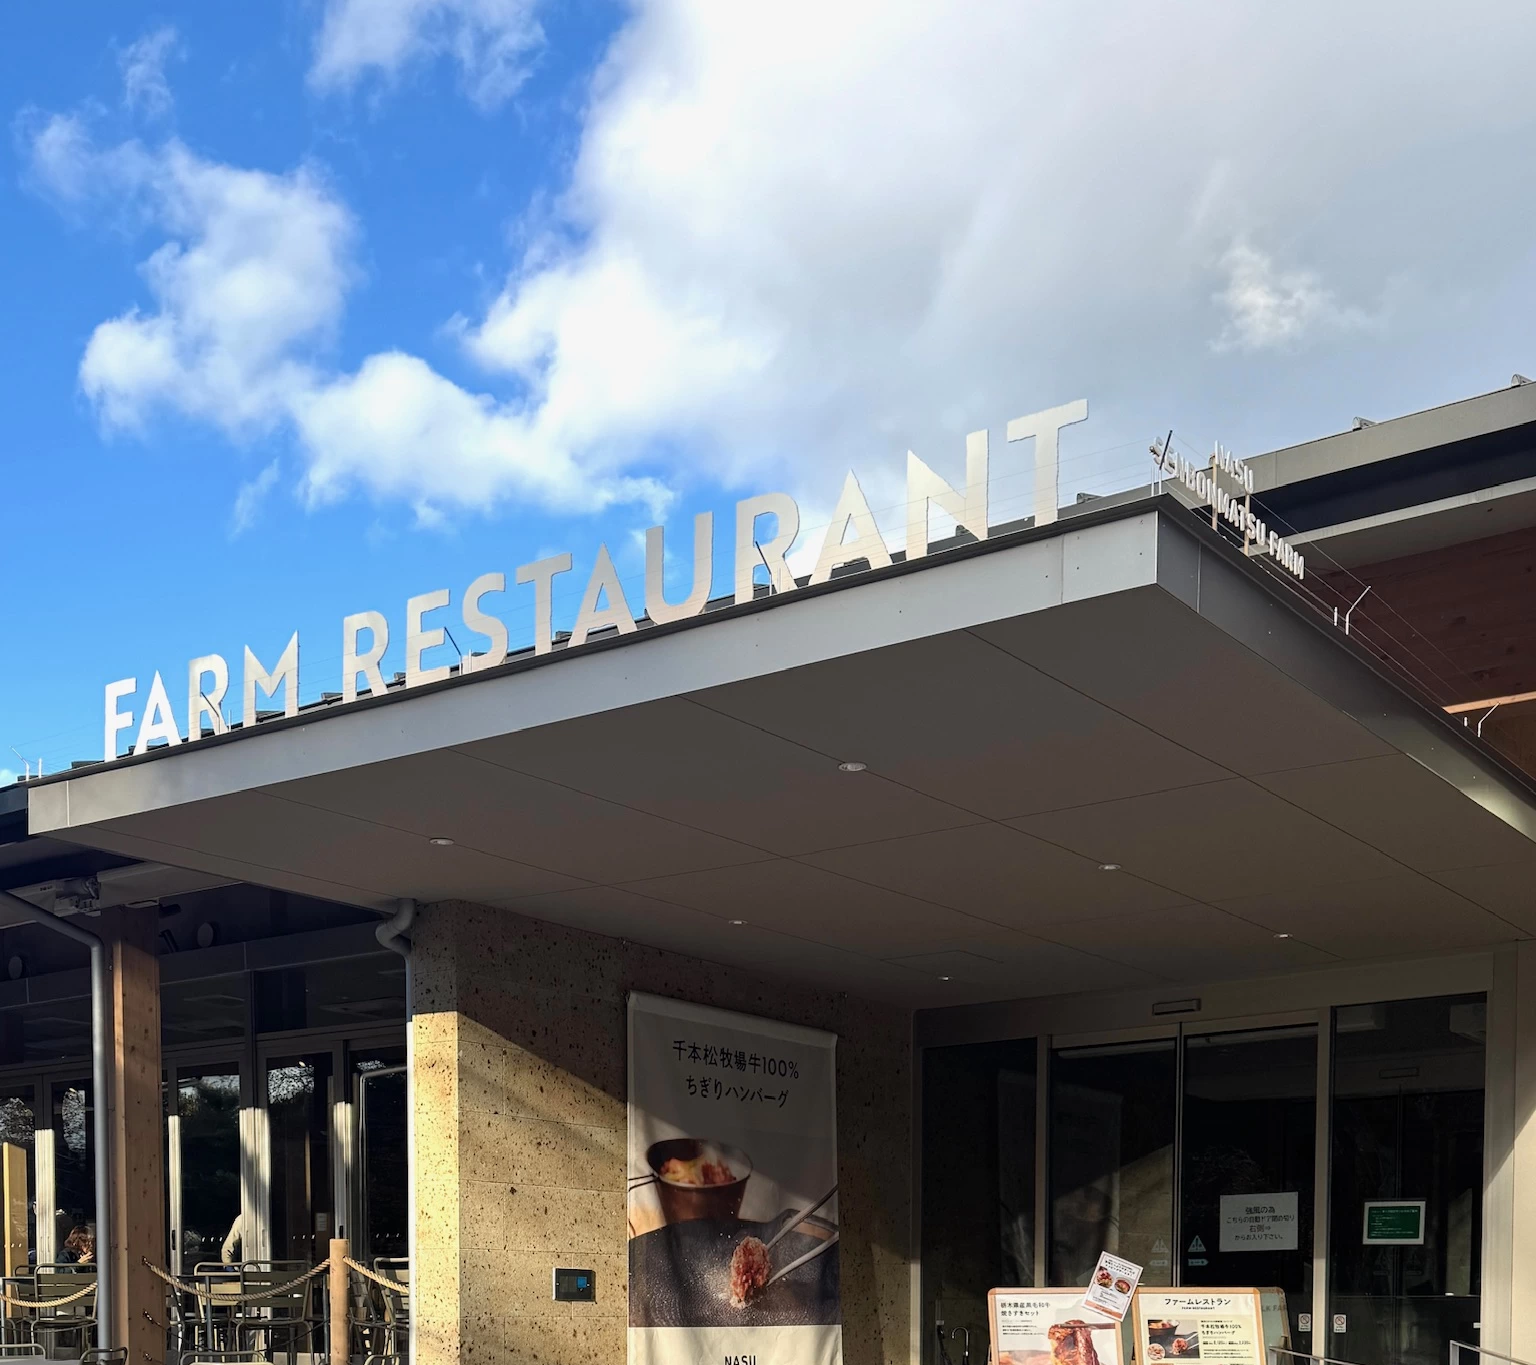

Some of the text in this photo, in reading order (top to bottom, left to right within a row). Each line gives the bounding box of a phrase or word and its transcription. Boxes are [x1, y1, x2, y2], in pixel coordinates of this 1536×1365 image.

[1214, 440, 1254, 494] NASU
[1149, 436, 1305, 580] SENBONMATSU FARM
[105, 398, 1089, 763] FARM RESTAURANT
[673, 1040, 799, 1079] 千本松牧場牛100%
[686, 1075, 789, 1108] ちぎりハンバーグ
[1165, 1298, 1232, 1306] ファームレストラン
